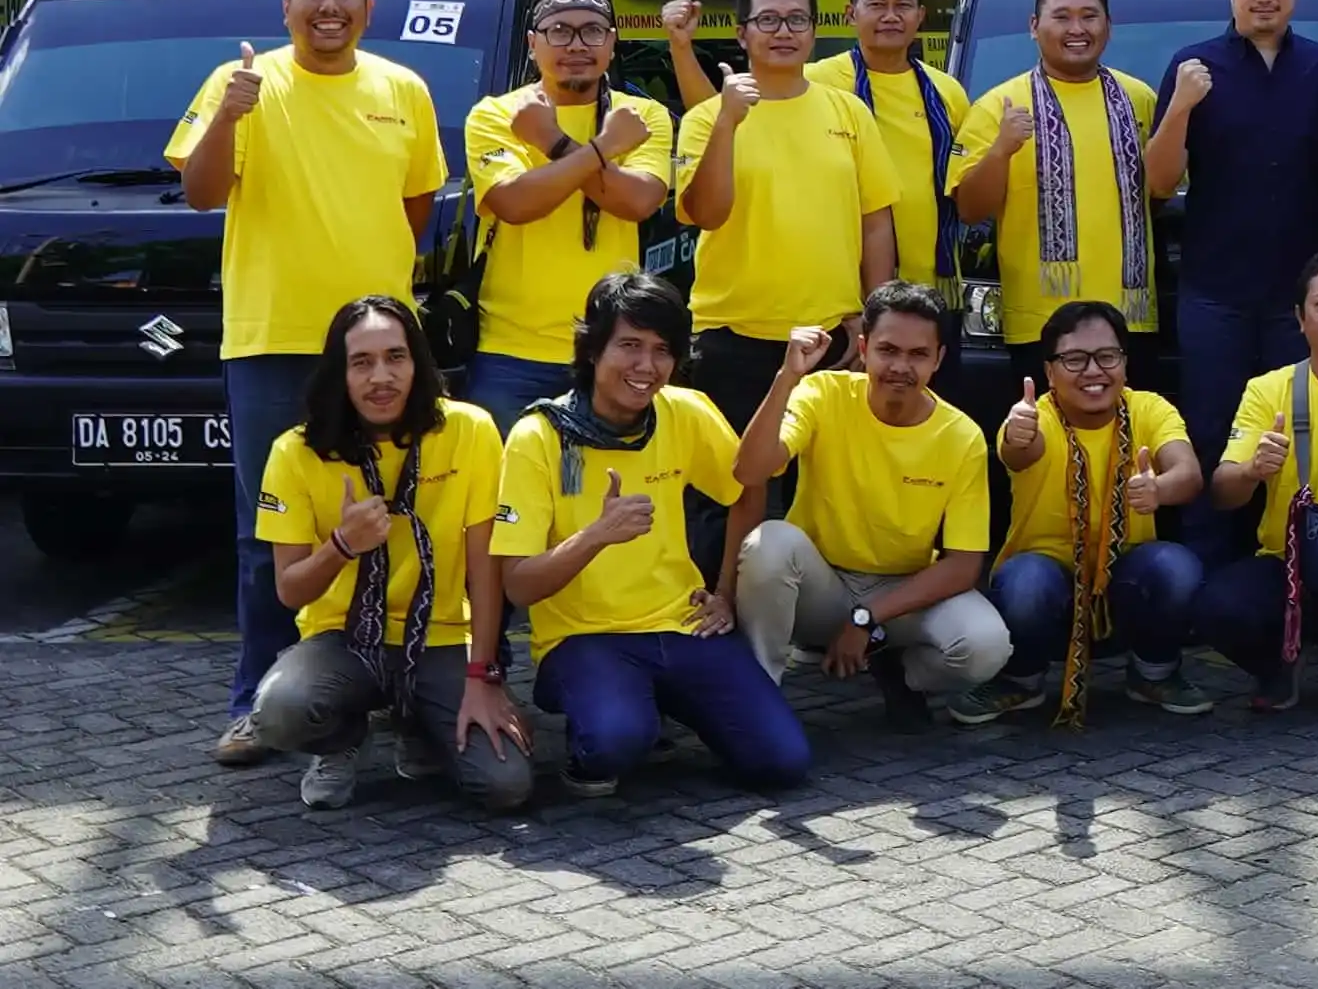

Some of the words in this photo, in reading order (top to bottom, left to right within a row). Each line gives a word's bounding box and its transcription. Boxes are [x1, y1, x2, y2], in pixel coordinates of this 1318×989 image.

[409, 15, 455, 35] 05
[79, 417, 110, 448] DA
[122, 417, 183, 448] 8105
